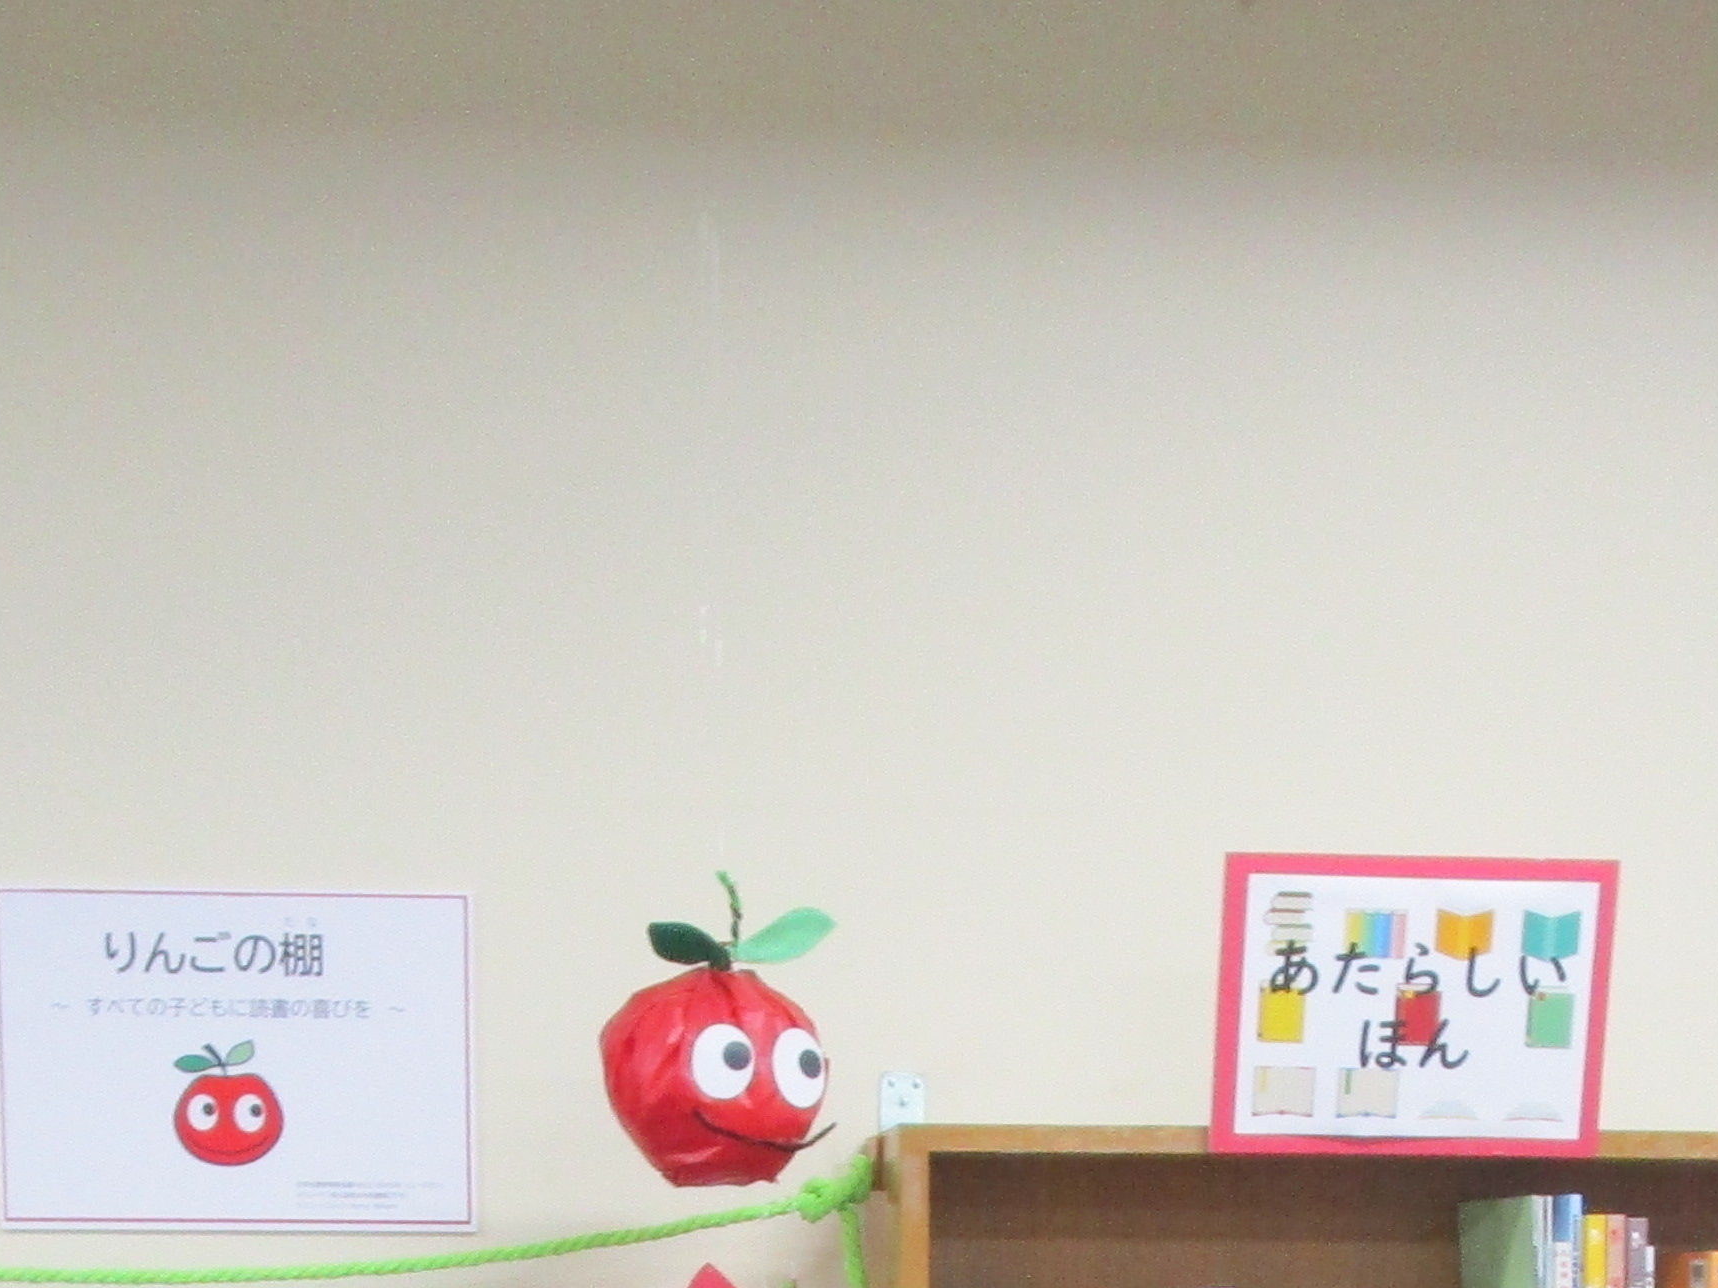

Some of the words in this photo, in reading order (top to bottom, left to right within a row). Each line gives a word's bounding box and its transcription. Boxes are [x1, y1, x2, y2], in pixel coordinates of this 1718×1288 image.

[104, 929, 324, 978] りんごの棚
[1270, 941, 1568, 998] あたらしい
[1359, 1017, 1470, 1070] ほん
